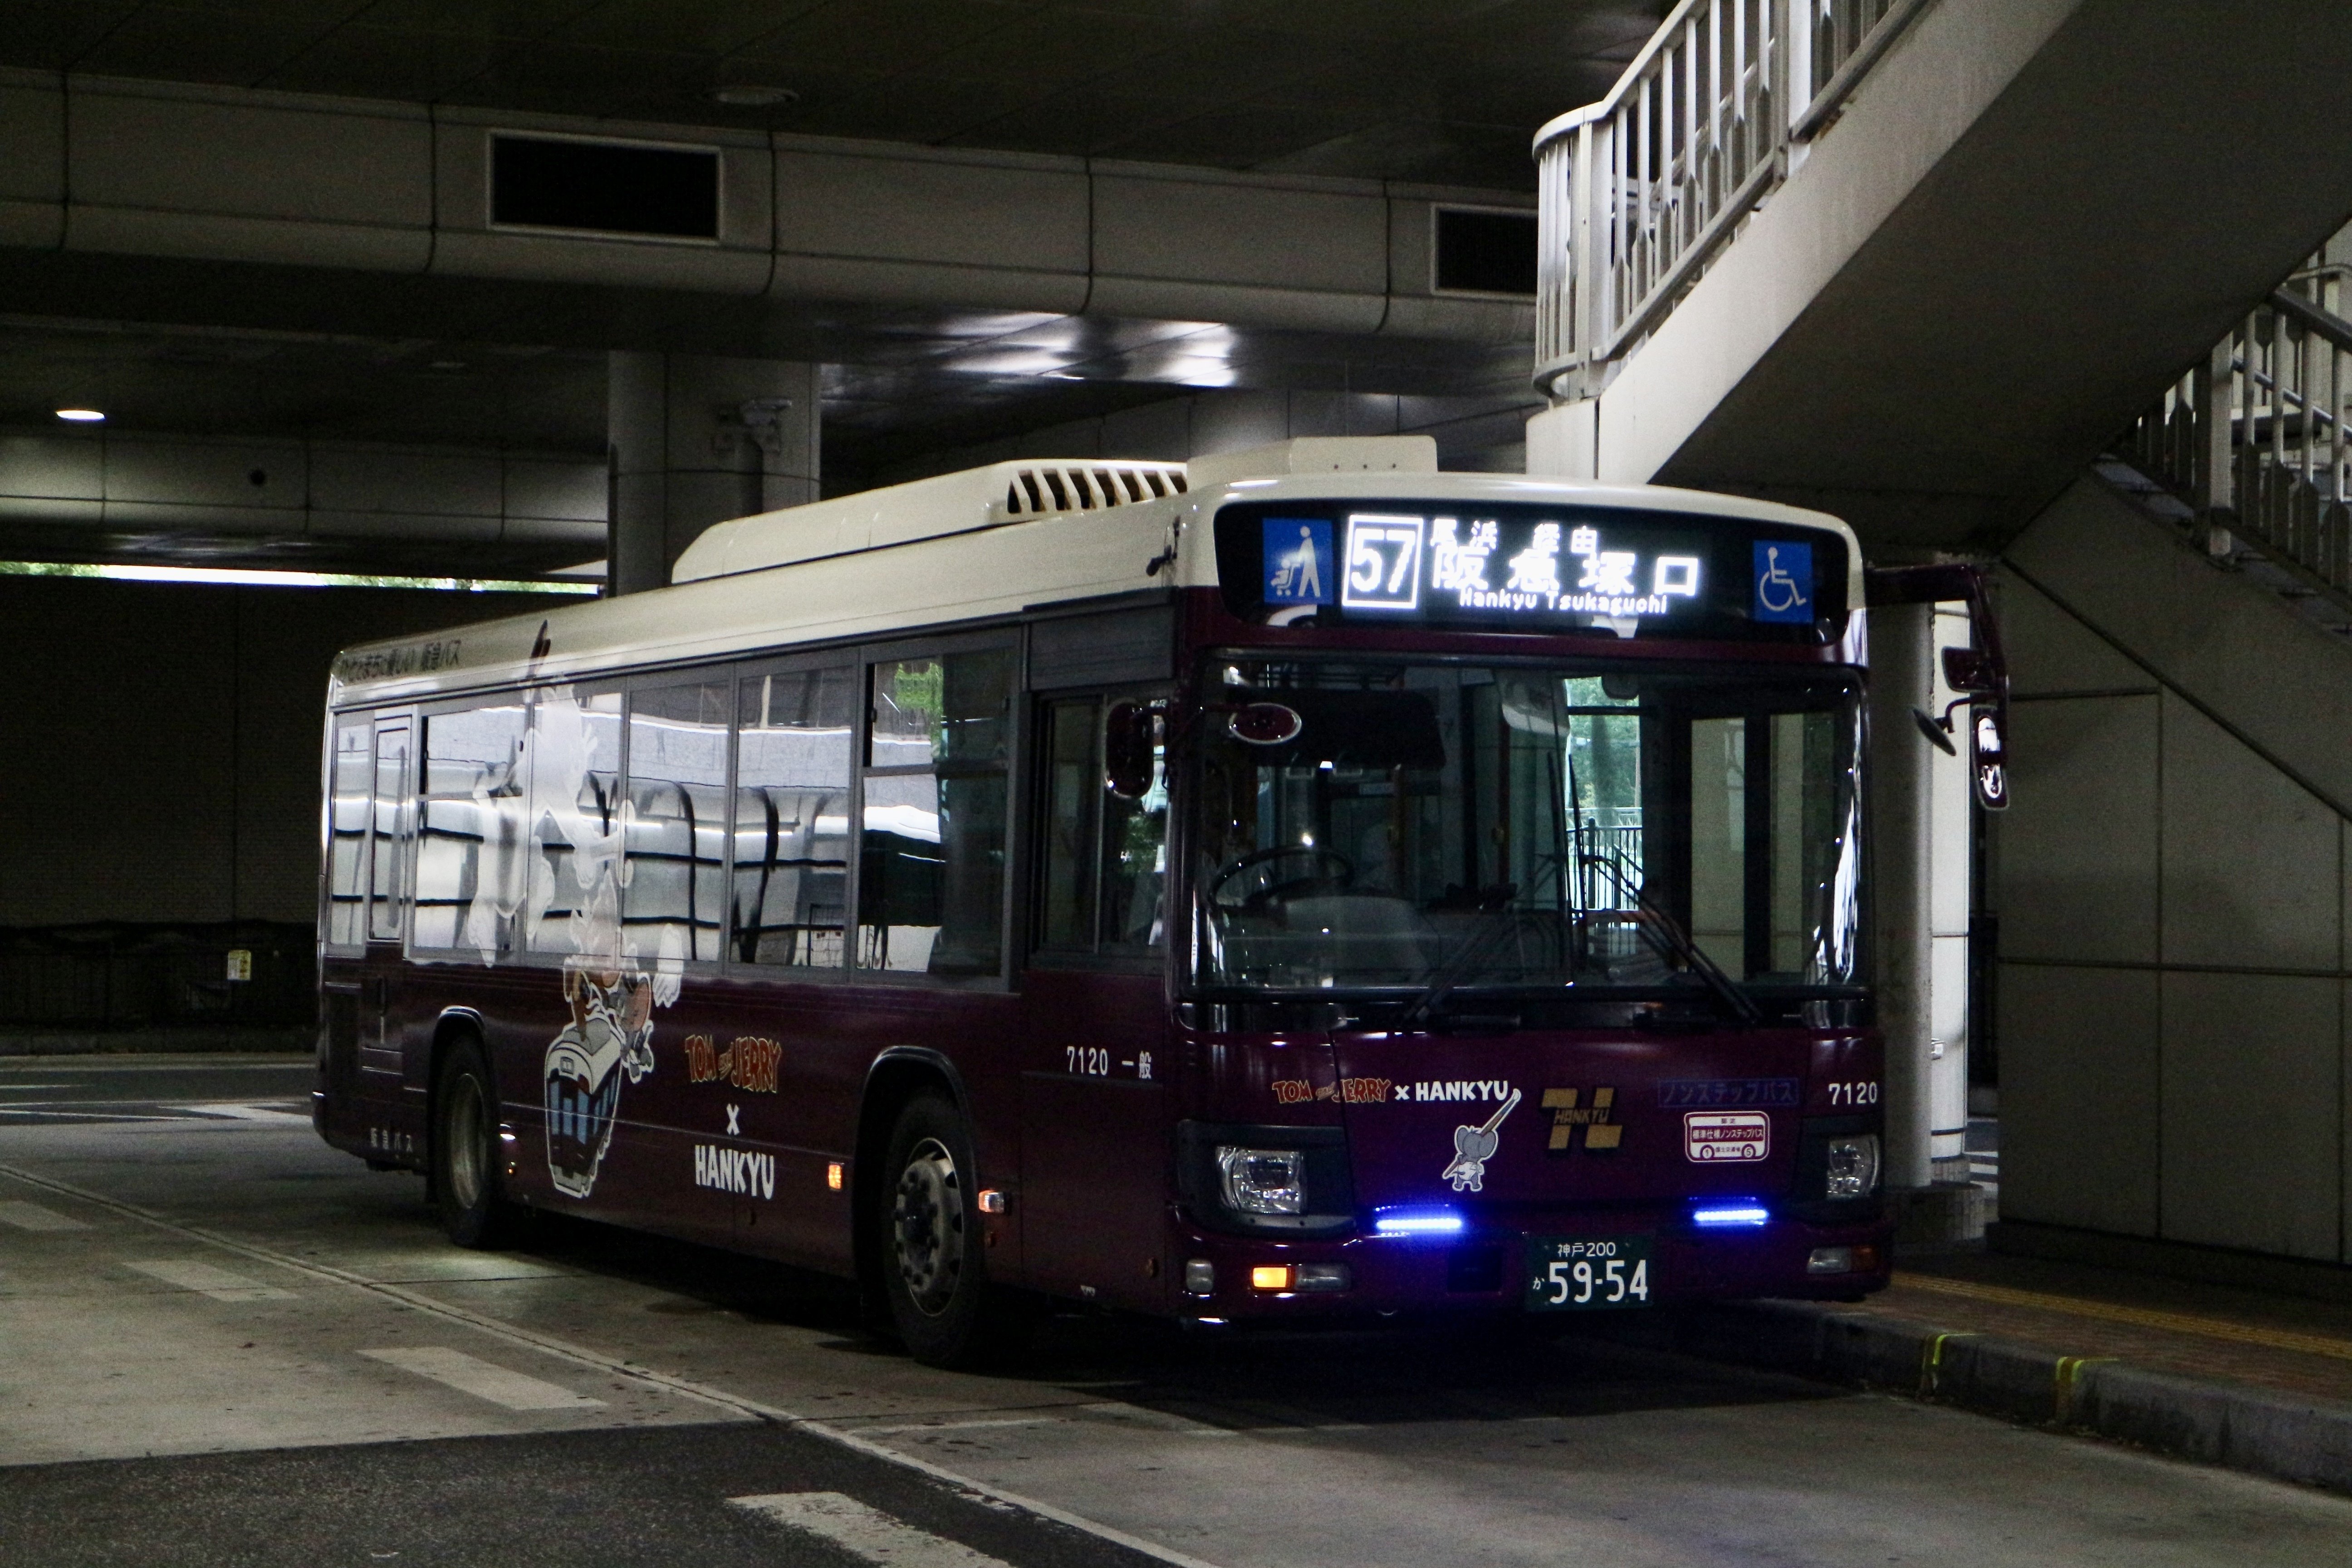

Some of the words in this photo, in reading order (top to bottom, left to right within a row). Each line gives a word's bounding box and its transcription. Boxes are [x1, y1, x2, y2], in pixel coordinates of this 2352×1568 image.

[1351, 528, 1416, 593] 57
[1432, 544, 1699, 596] 阪急塚口
[1460, 587, 1538, 611] Hankyu
[1546, 590, 1667, 615] Tsukaguchi
[684, 1034, 716, 1083] TOM
[730, 1036, 782, 1093] JERRY
[1066, 1045, 1108, 1076] 7120
[1272, 1079, 1313, 1103] TOM
[1331, 1078, 1392, 1103] JERRY
[1415, 1080, 1509, 1102] HANKYU
[1828, 1081, 1877, 1105] 7120
[1553, 1108, 1610, 1125] HANKYU
[695, 1144, 774, 1200] HANKYU
[1532, 1277, 1545, 1290] か
[1548, 1259, 1648, 1304] 59-54
